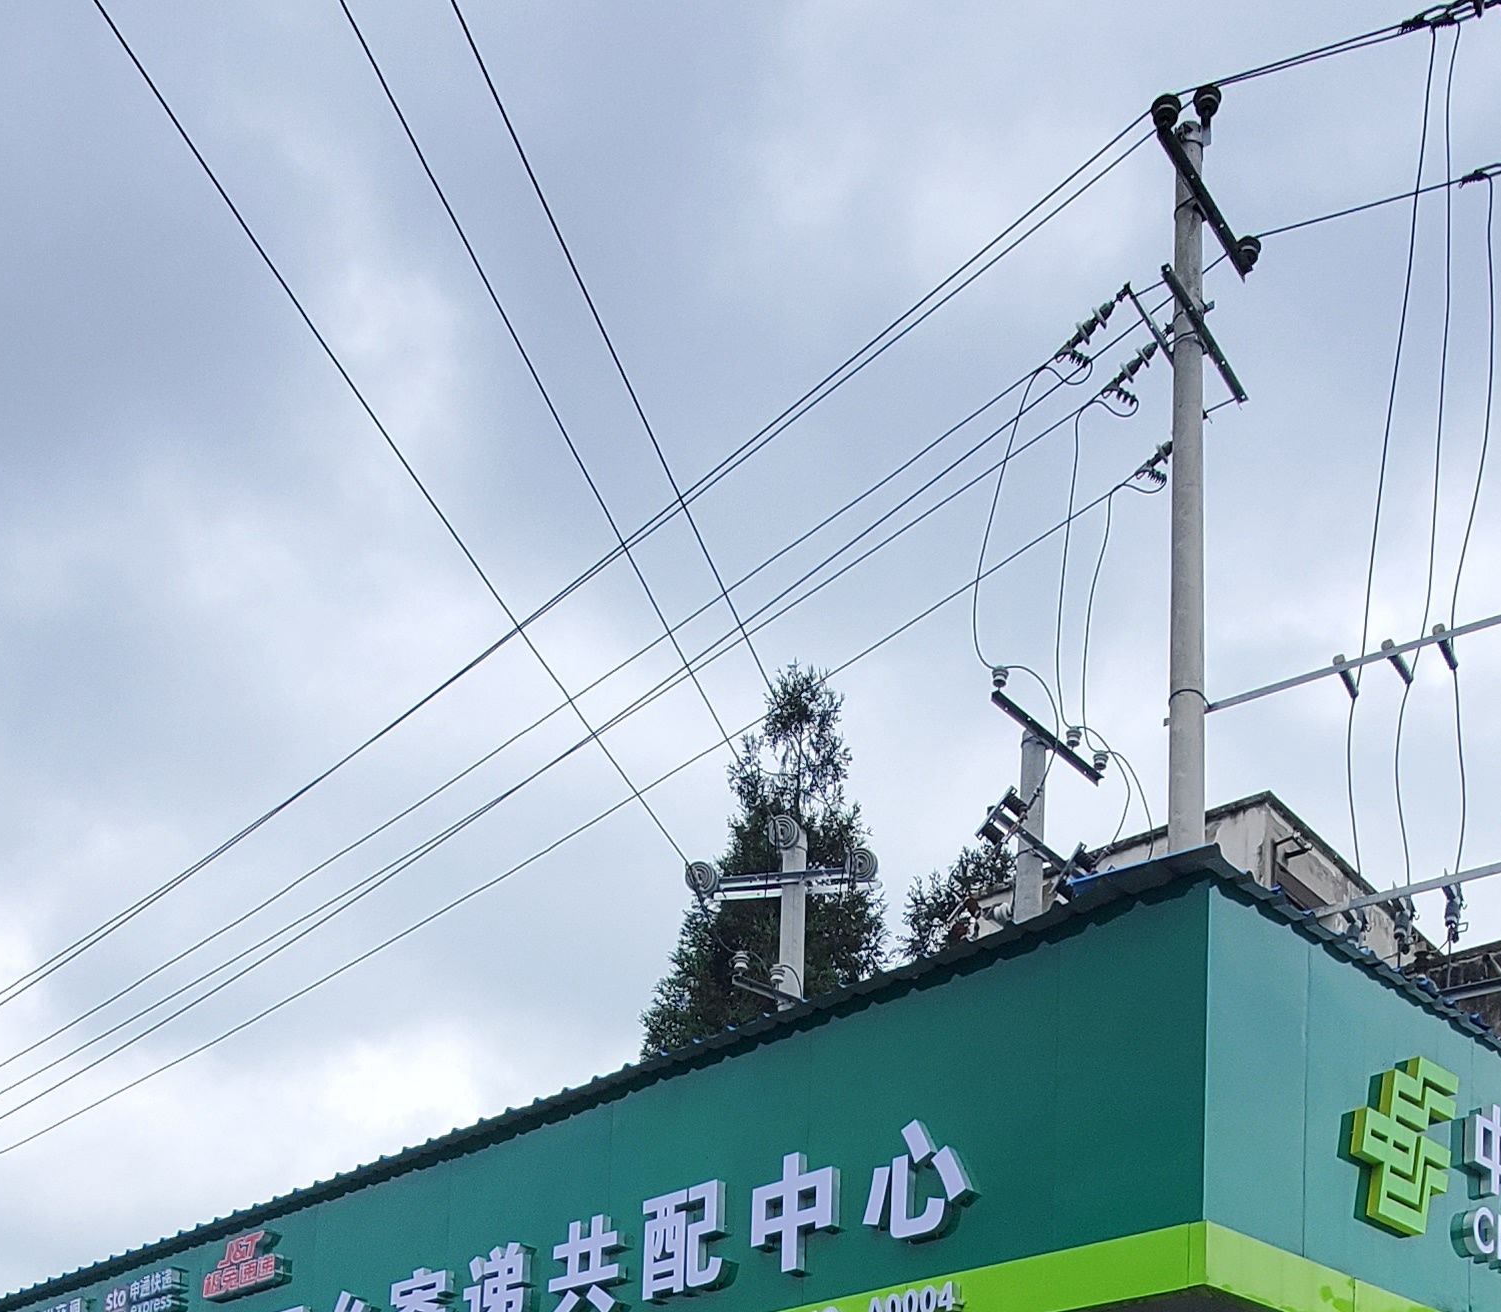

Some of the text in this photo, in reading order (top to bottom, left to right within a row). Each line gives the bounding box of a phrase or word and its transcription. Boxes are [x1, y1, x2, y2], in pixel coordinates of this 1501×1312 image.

[217, 1230, 265, 1268] J&T
[130, 1268, 173, 1300] 申通快递
[203, 1253, 275, 1298] 极兔速递
[105, 1288, 126, 1311] sto
